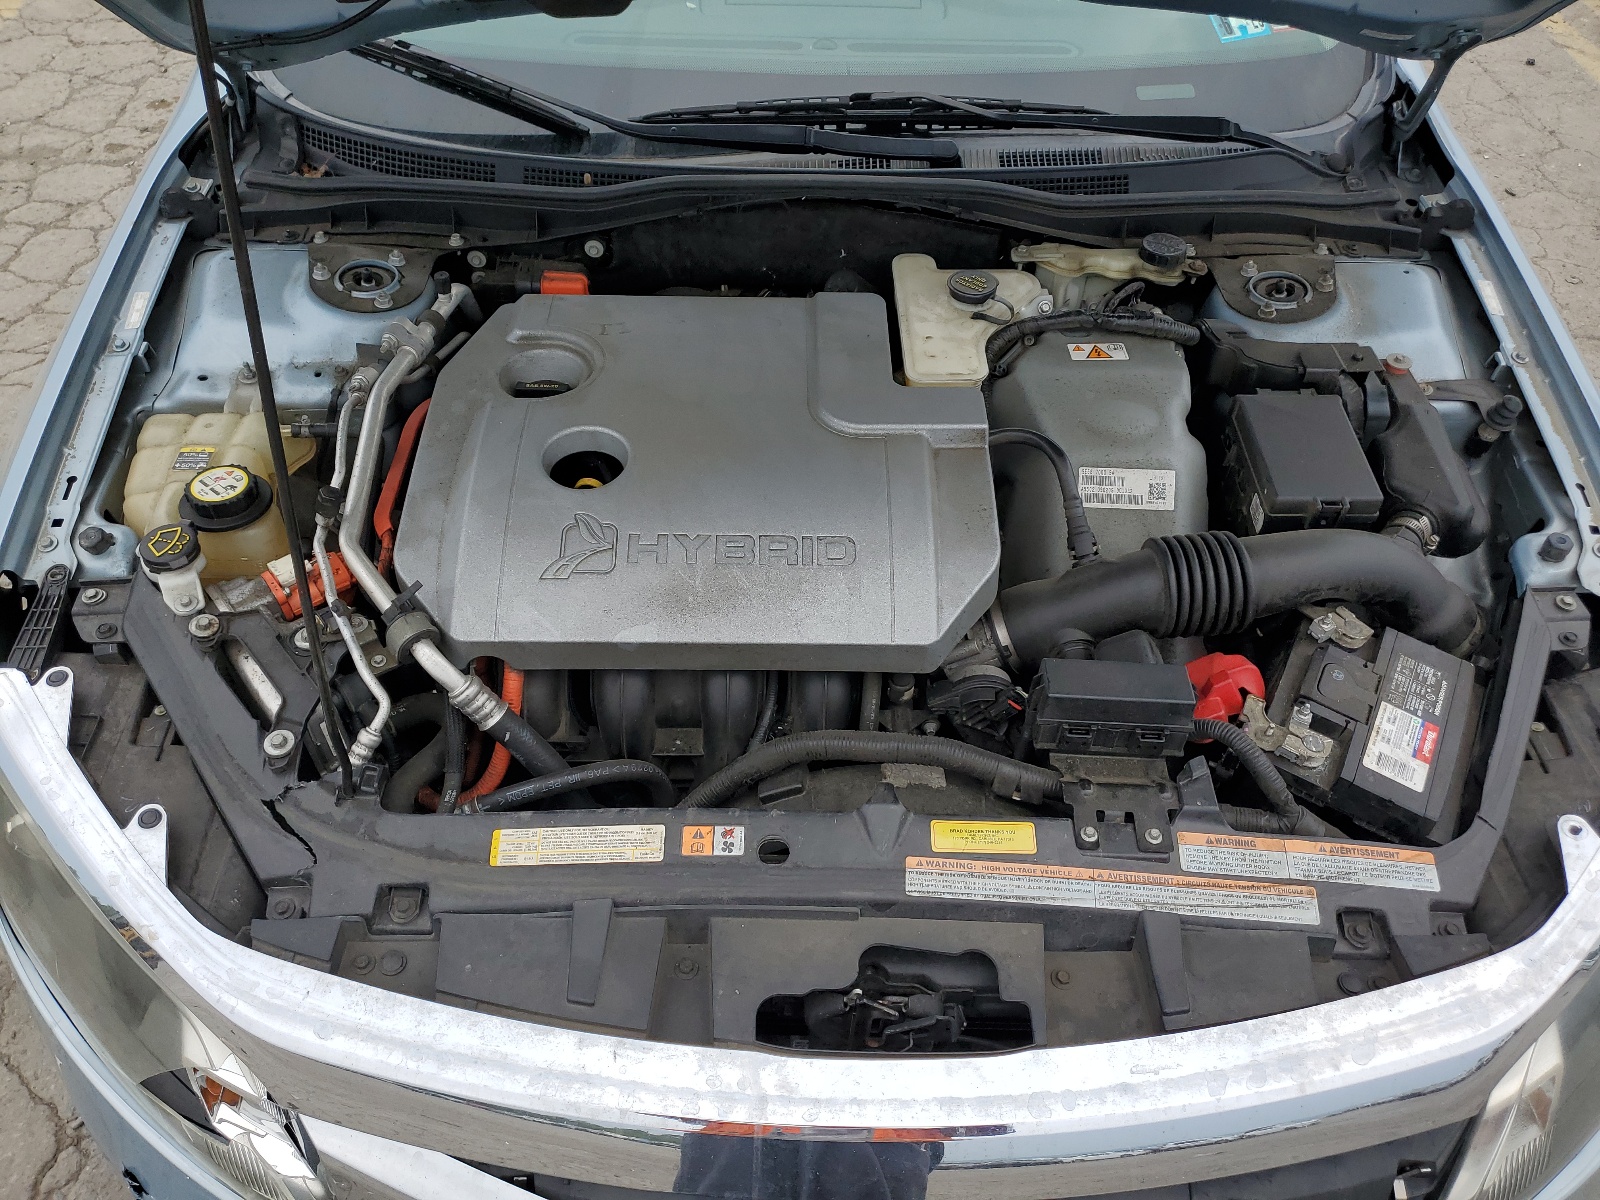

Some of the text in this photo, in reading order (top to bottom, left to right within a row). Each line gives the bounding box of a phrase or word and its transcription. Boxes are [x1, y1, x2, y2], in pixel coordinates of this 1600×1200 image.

[626, 531, 857, 567] HYBRID
[1215, 836, 1257, 849] WARNING
[1329, 846, 1400, 860] AVERTISSEMENT
[925, 859, 1073, 877] WARNING: HIGH VOLTAGE VEHICLE
[1107, 872, 1175, 885] AVERTISSEMENT
